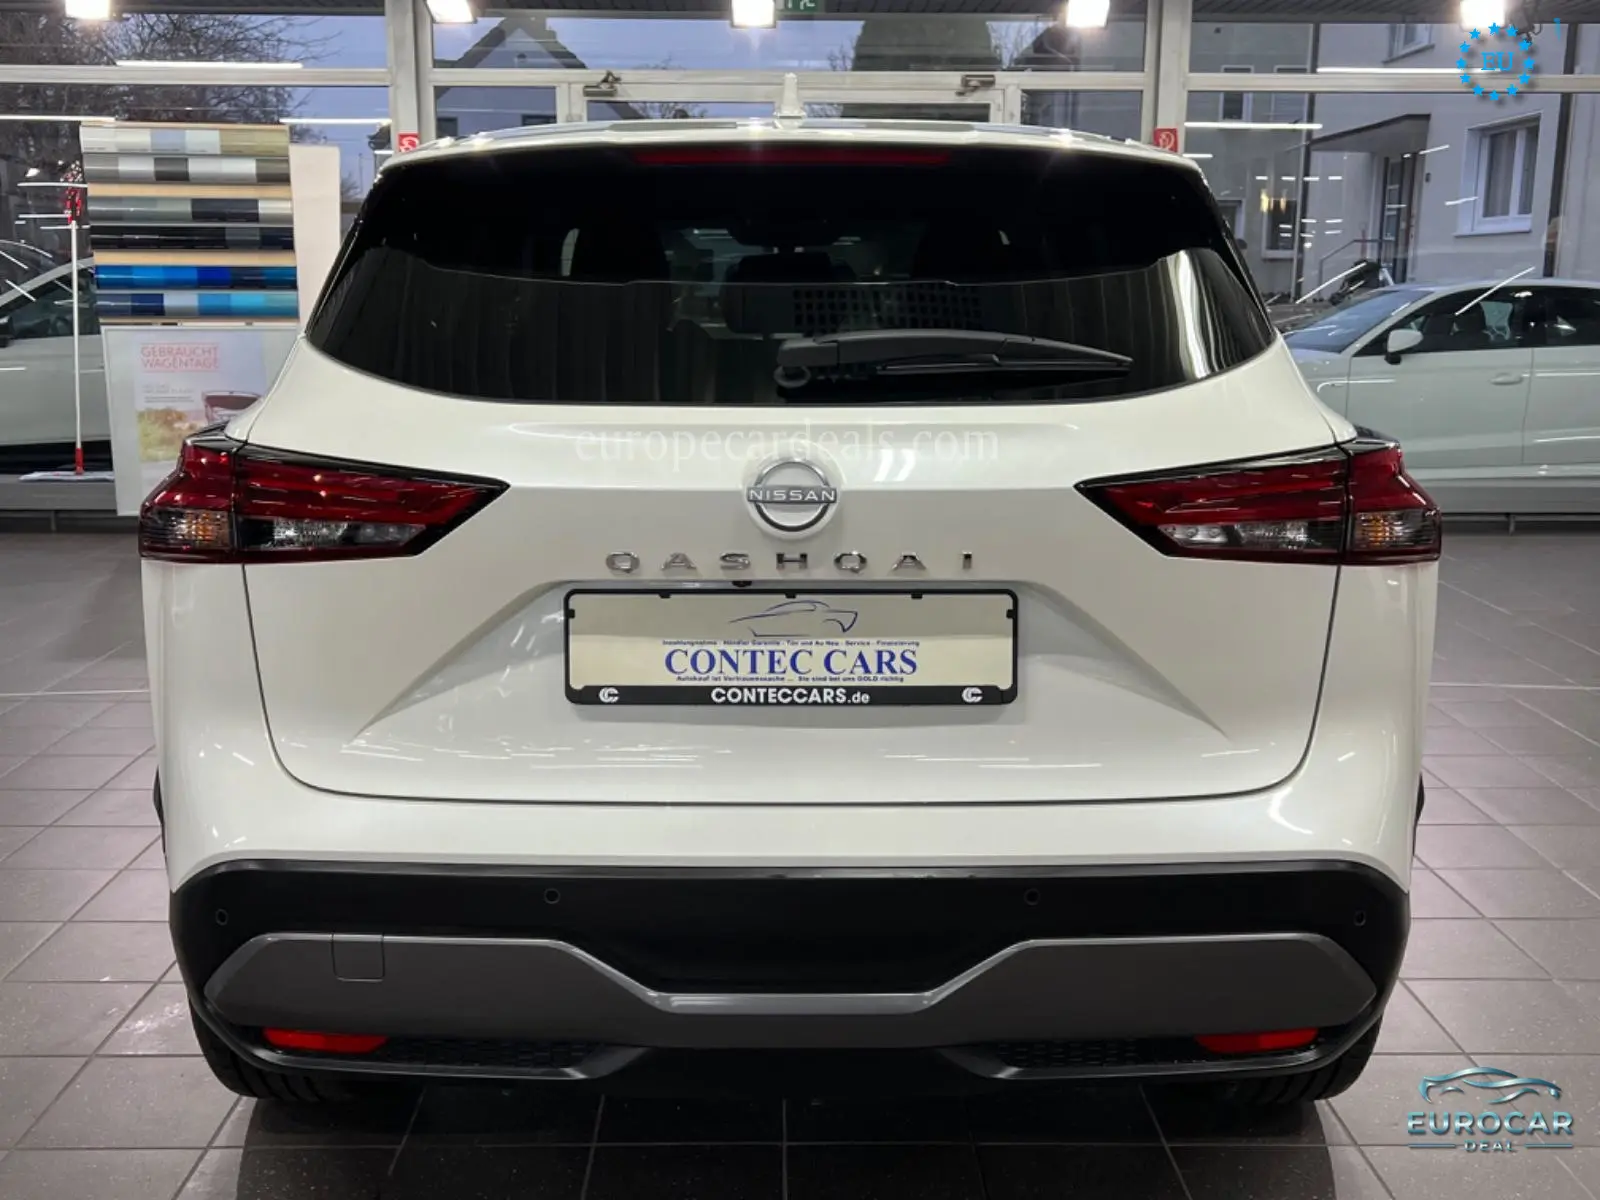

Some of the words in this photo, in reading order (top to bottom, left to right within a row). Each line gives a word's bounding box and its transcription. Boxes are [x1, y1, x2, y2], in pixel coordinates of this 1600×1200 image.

[141, 345, 218, 357] GEBRAUCHT
[141, 357, 219, 369] WAGENTAGE
[749, 489, 836, 501] NISSAN
[605, 550, 973, 574] QASHQAI
[665, 648, 813, 675] CONTEC
[824, 648, 917, 675] CARS
[711, 687, 870, 704] CONTECCARS.de
